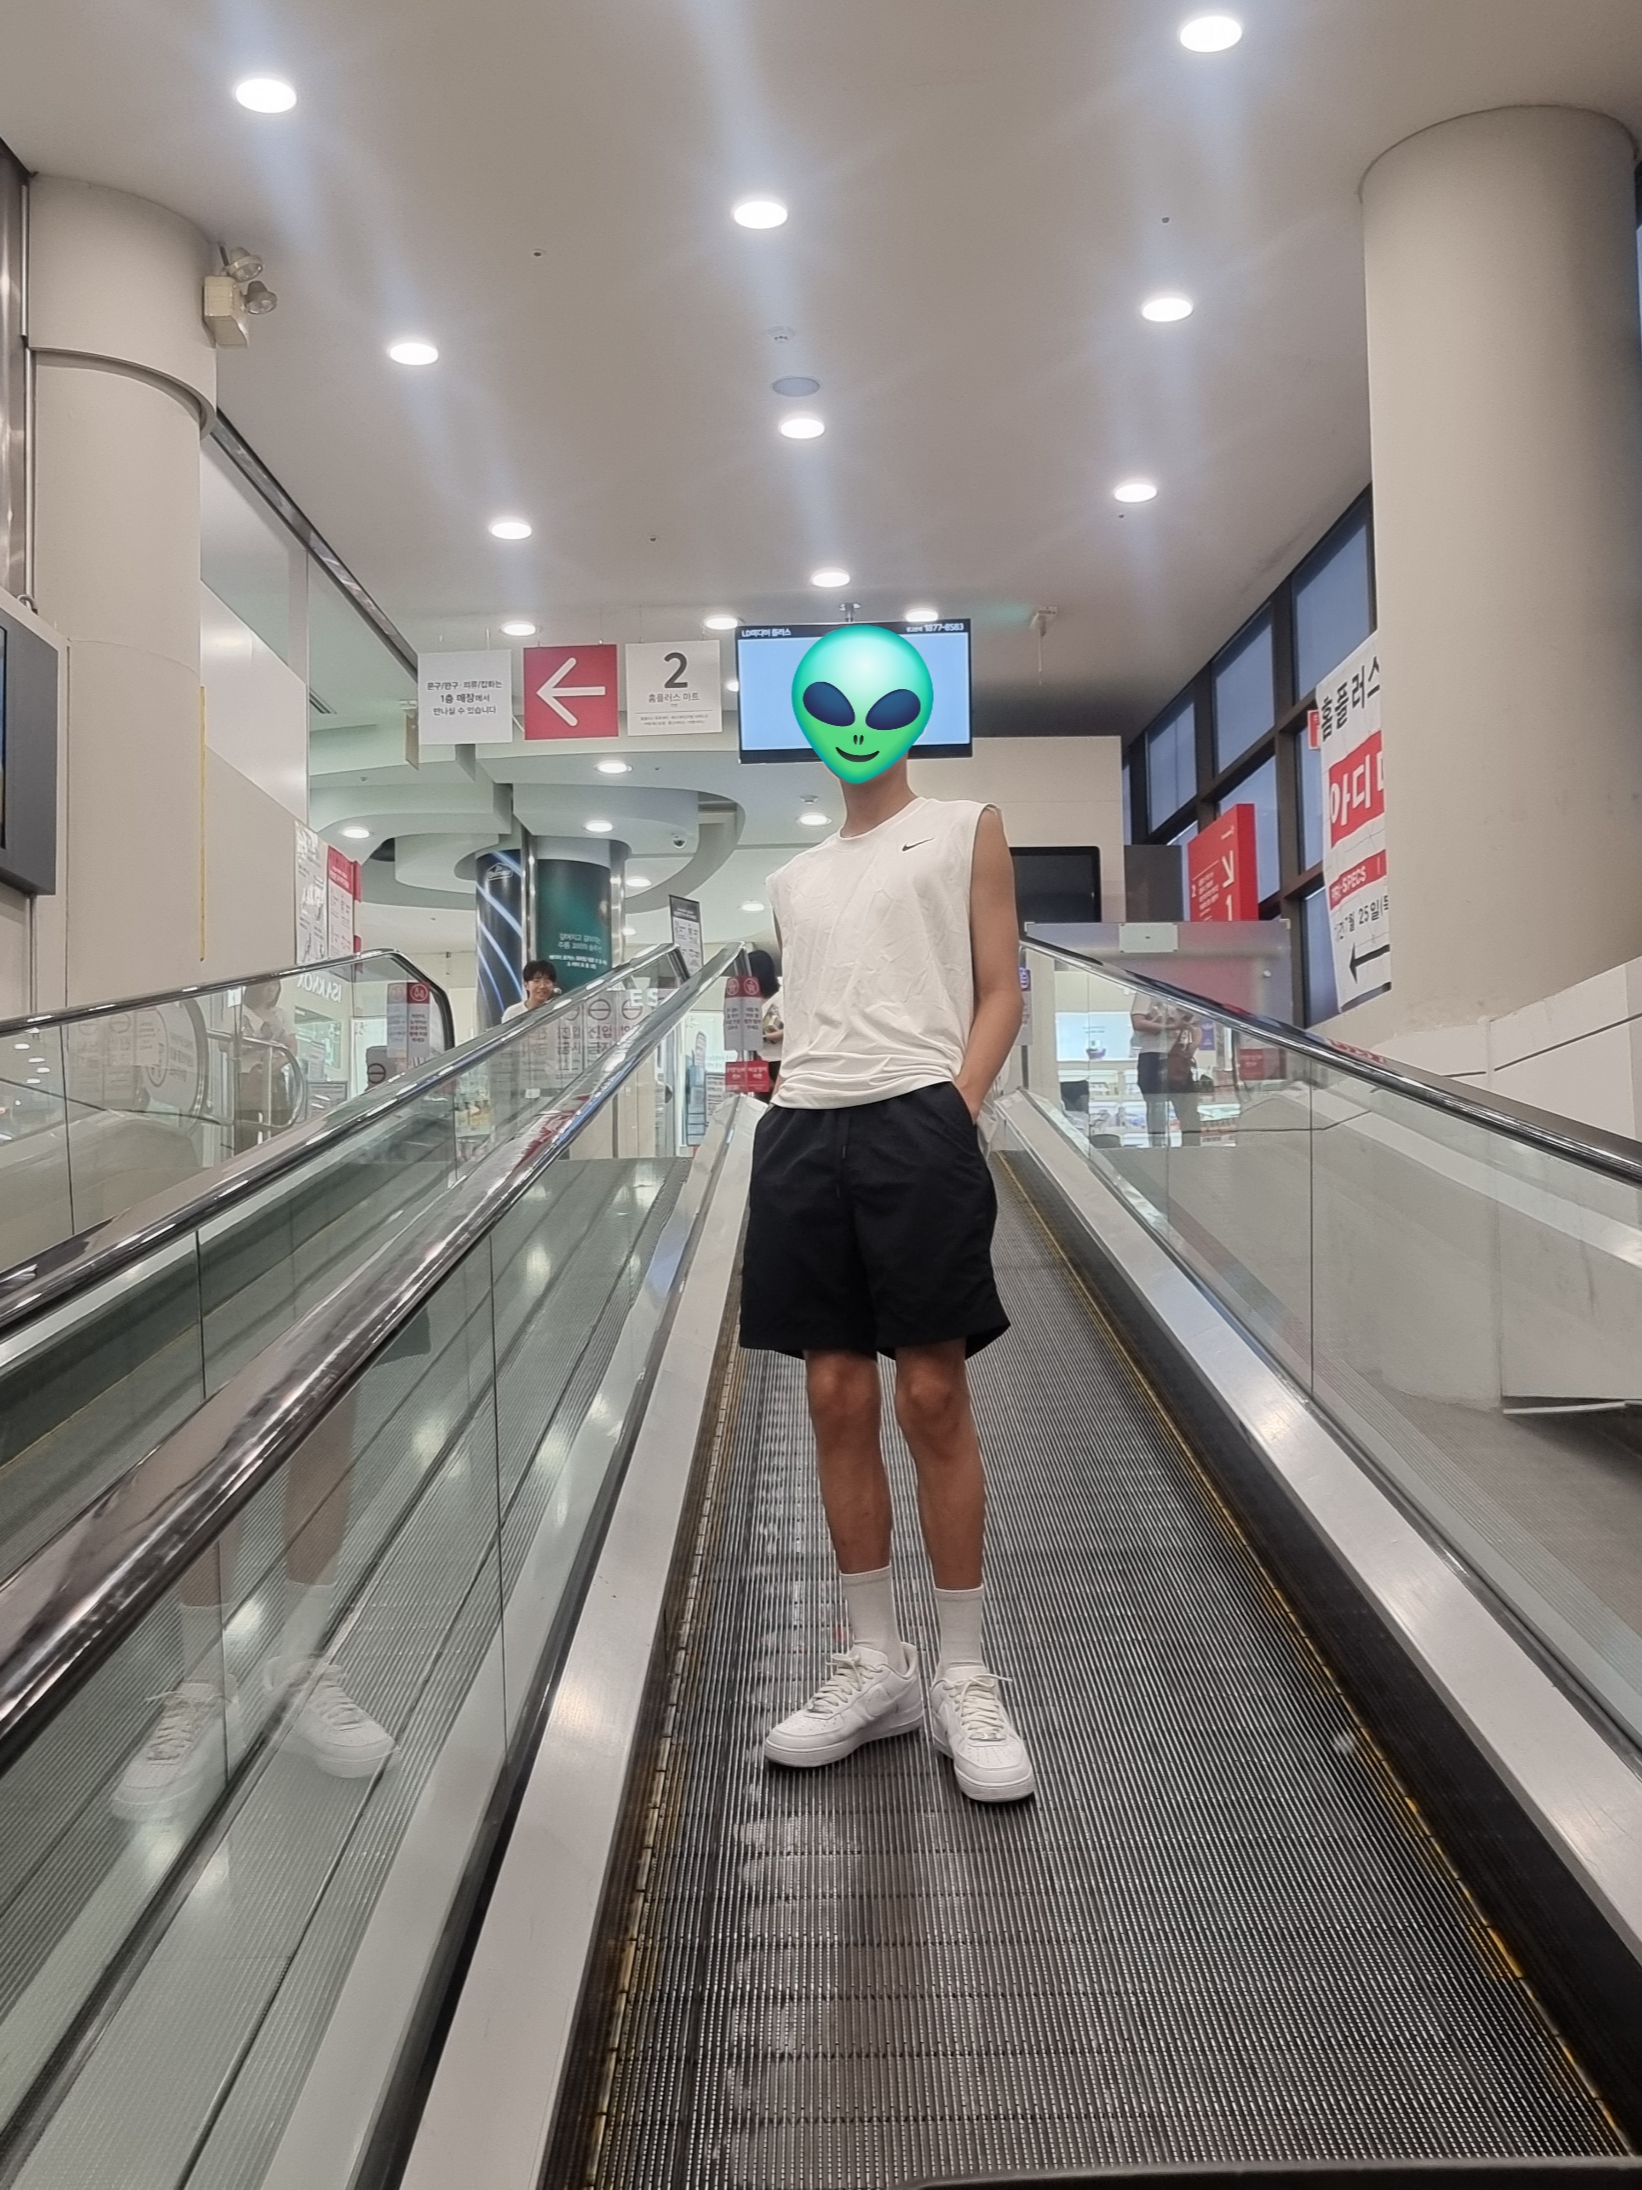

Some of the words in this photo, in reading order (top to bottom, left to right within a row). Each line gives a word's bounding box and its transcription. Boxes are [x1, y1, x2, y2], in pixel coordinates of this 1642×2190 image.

[664, 652, 688, 688] 2
[440, 693, 454, 704] 1층
[648, 692, 681, 703] 홈플러스
[682, 691, 700, 702] 마트
[457, 706, 466, 715] 수
[466, 705, 497, 715] 있습니다
